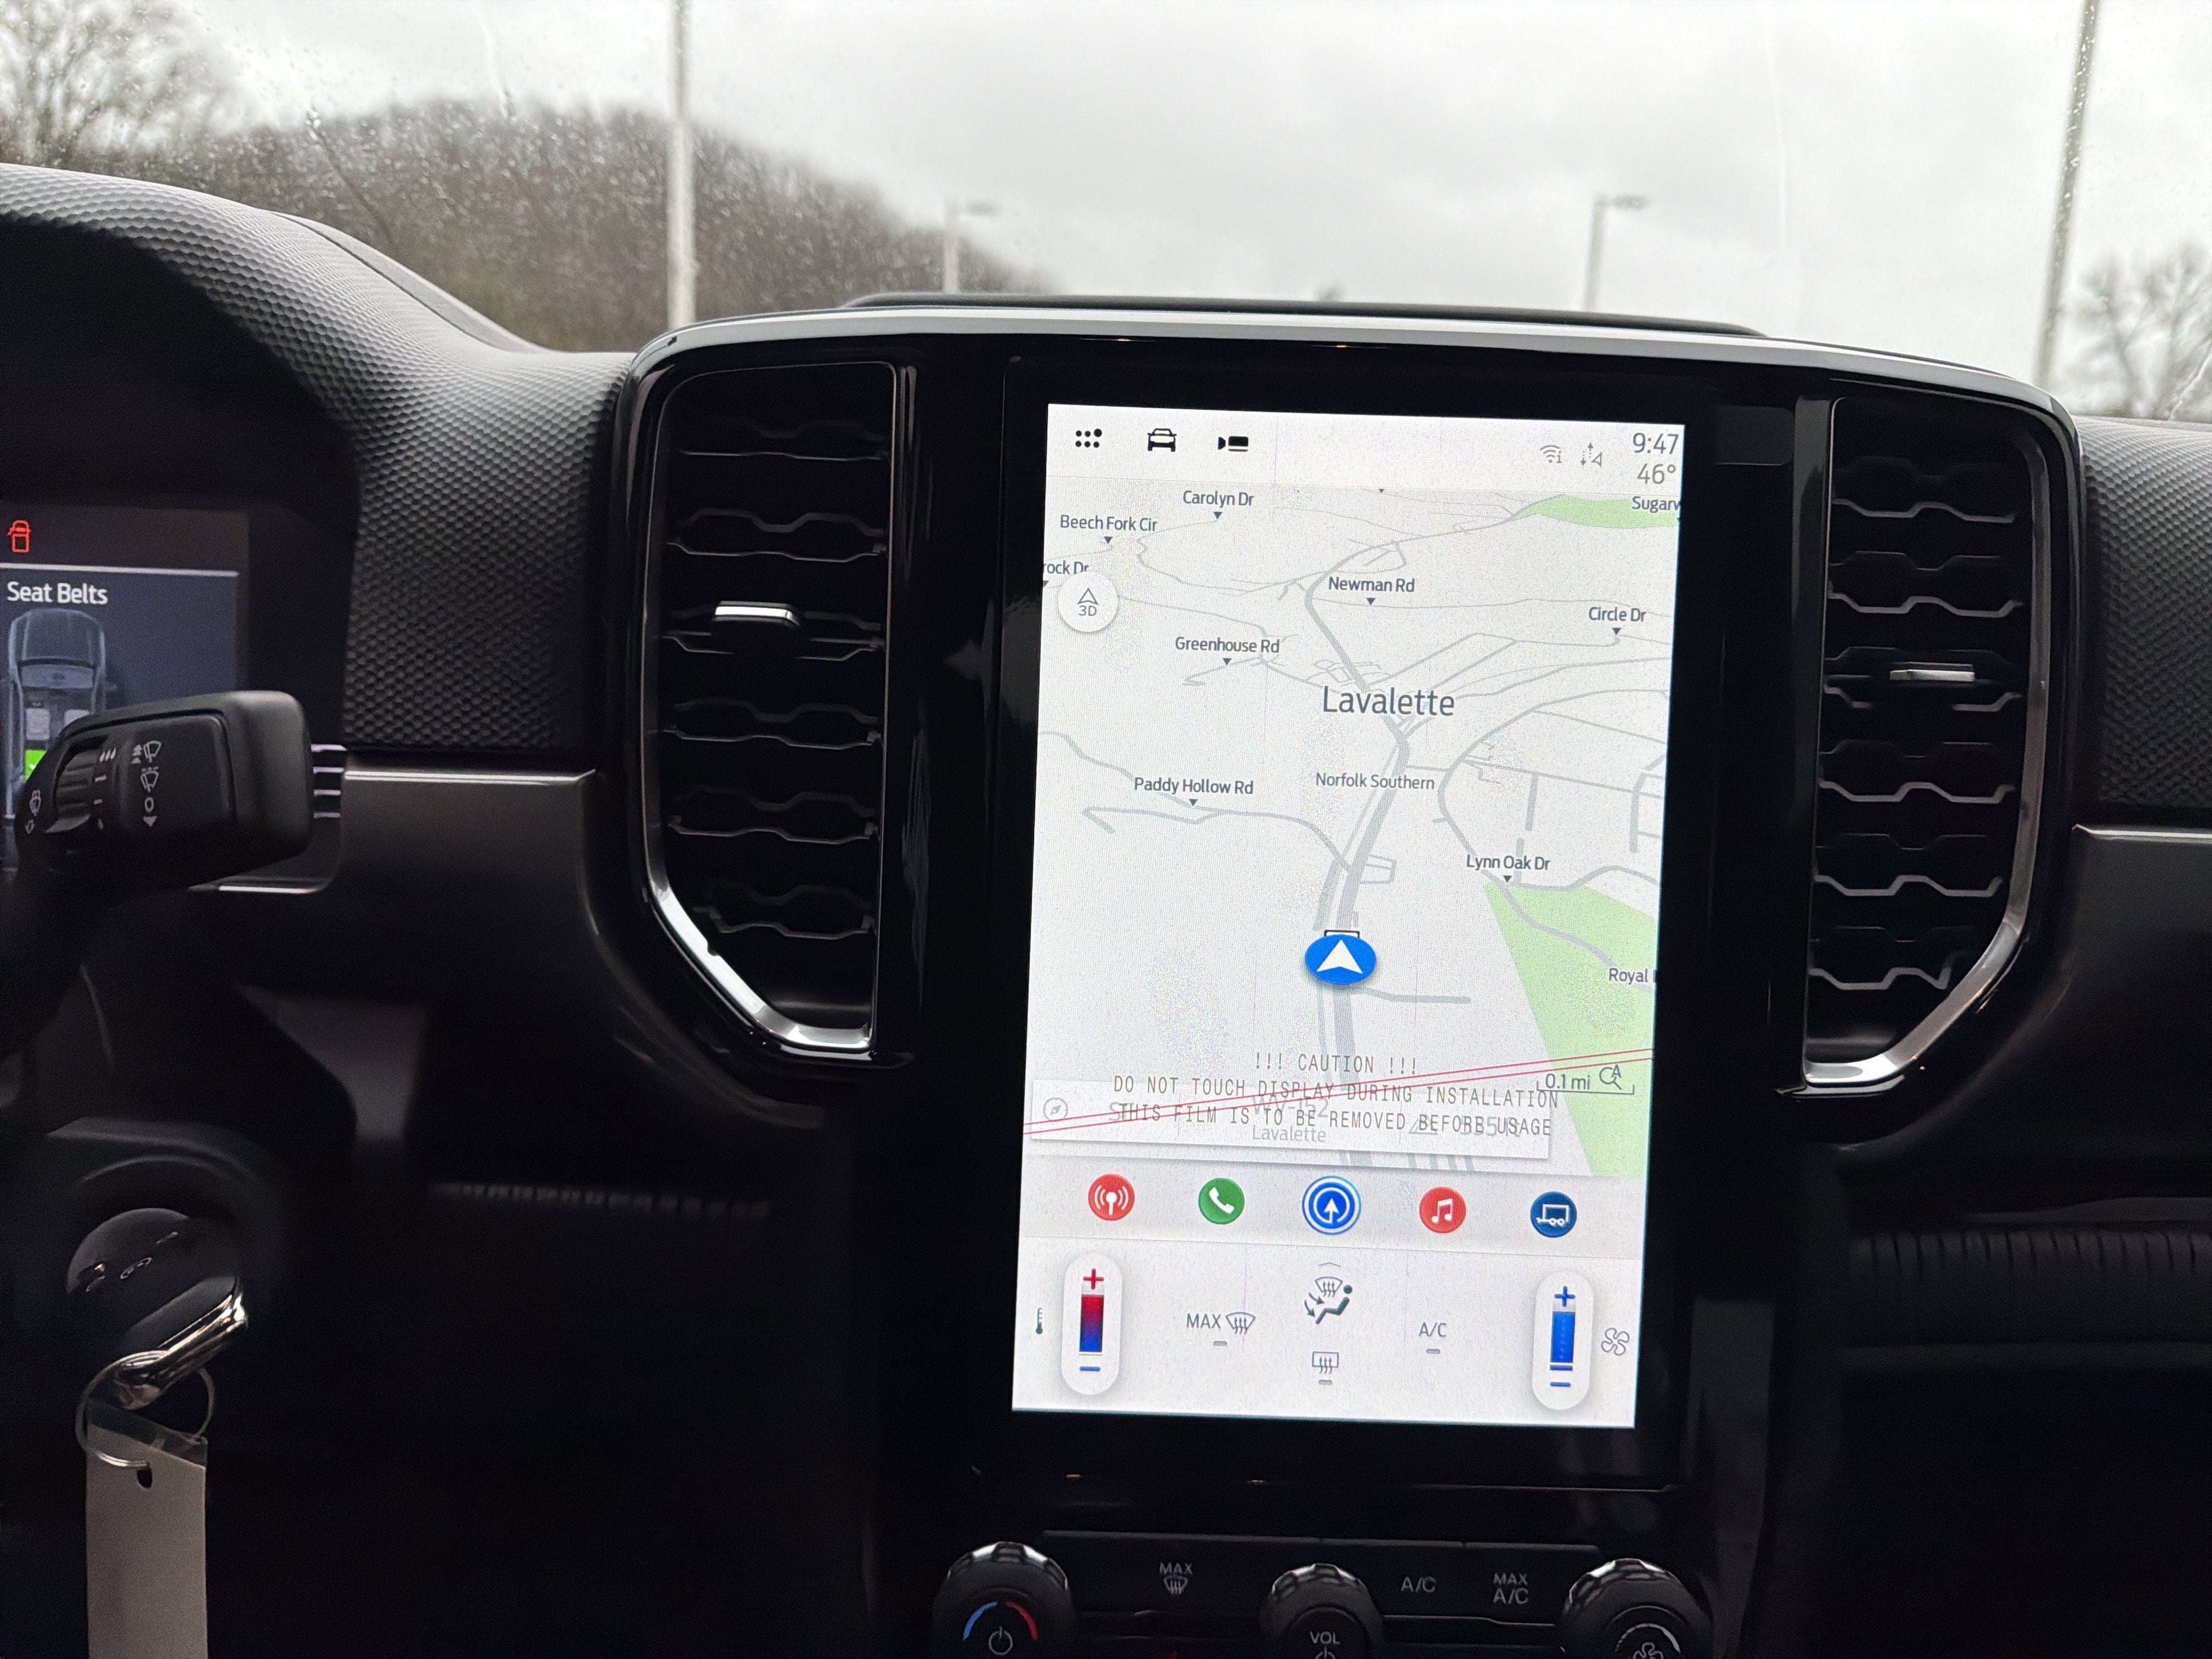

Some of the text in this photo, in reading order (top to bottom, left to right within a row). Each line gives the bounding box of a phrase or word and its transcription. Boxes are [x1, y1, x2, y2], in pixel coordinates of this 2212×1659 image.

[1633, 432, 1679, 454] 9:47
[1637, 463, 1677, 484] 46°
[1183, 490, 1254, 508] Carolyn Dr
[1060, 515, 1158, 532] Beech Fork Cir
[1074, 561, 1089, 574] Dr
[1328, 576, 1415, 592] Newman Rd
[7, 582, 108, 605] Seat Belts
[1079, 605, 1097, 616] 3D
[1588, 607, 1646, 622] Circle Dr
[1175, 636, 1279, 653] Greenhouse Rd
[1323, 686, 1455, 716] Lavalette
[1133, 777, 1254, 795] Paddy Hollow Rd
[1316, 772, 1435, 789] Norfolk Southern
[1466, 854, 1550, 871] Lynn Oak Dr
[1609, 968, 1647, 985] Royal
[1298, 1054, 1375, 1074] CAUTION
[1545, 1074, 1590, 1090] 0.1 mi
[1114, 1075, 1558, 1108] DO NOT TOUCH DISPLAY DURING INSTALLATION
[1119, 1103, 1160, 1121] THIS
[1175, 1104, 1216, 1123] FILM
[1231, 1107, 1249, 1124] IS
[1264, 1108, 1283, 1125] TO
[1296, 1109, 1316, 1126] BE
[1330, 1111, 1406, 1130] REMOVED
[1419, 1114, 1484, 1133] BEFORE
[1498, 1117, 1550, 1136] USAGE
[1253, 1125, 1326, 1142] Lavalette
[1187, 1313, 1221, 1329] MAX
[1419, 1322, 1447, 1337] A/C
[1159, 1562, 1193, 1575] MAX
[1401, 1577, 1436, 1592] A/C
[1493, 1573, 1528, 1585] MAX
[1493, 1588, 1529, 1605] A/C
[1310, 1630, 1340, 1645] VOL
